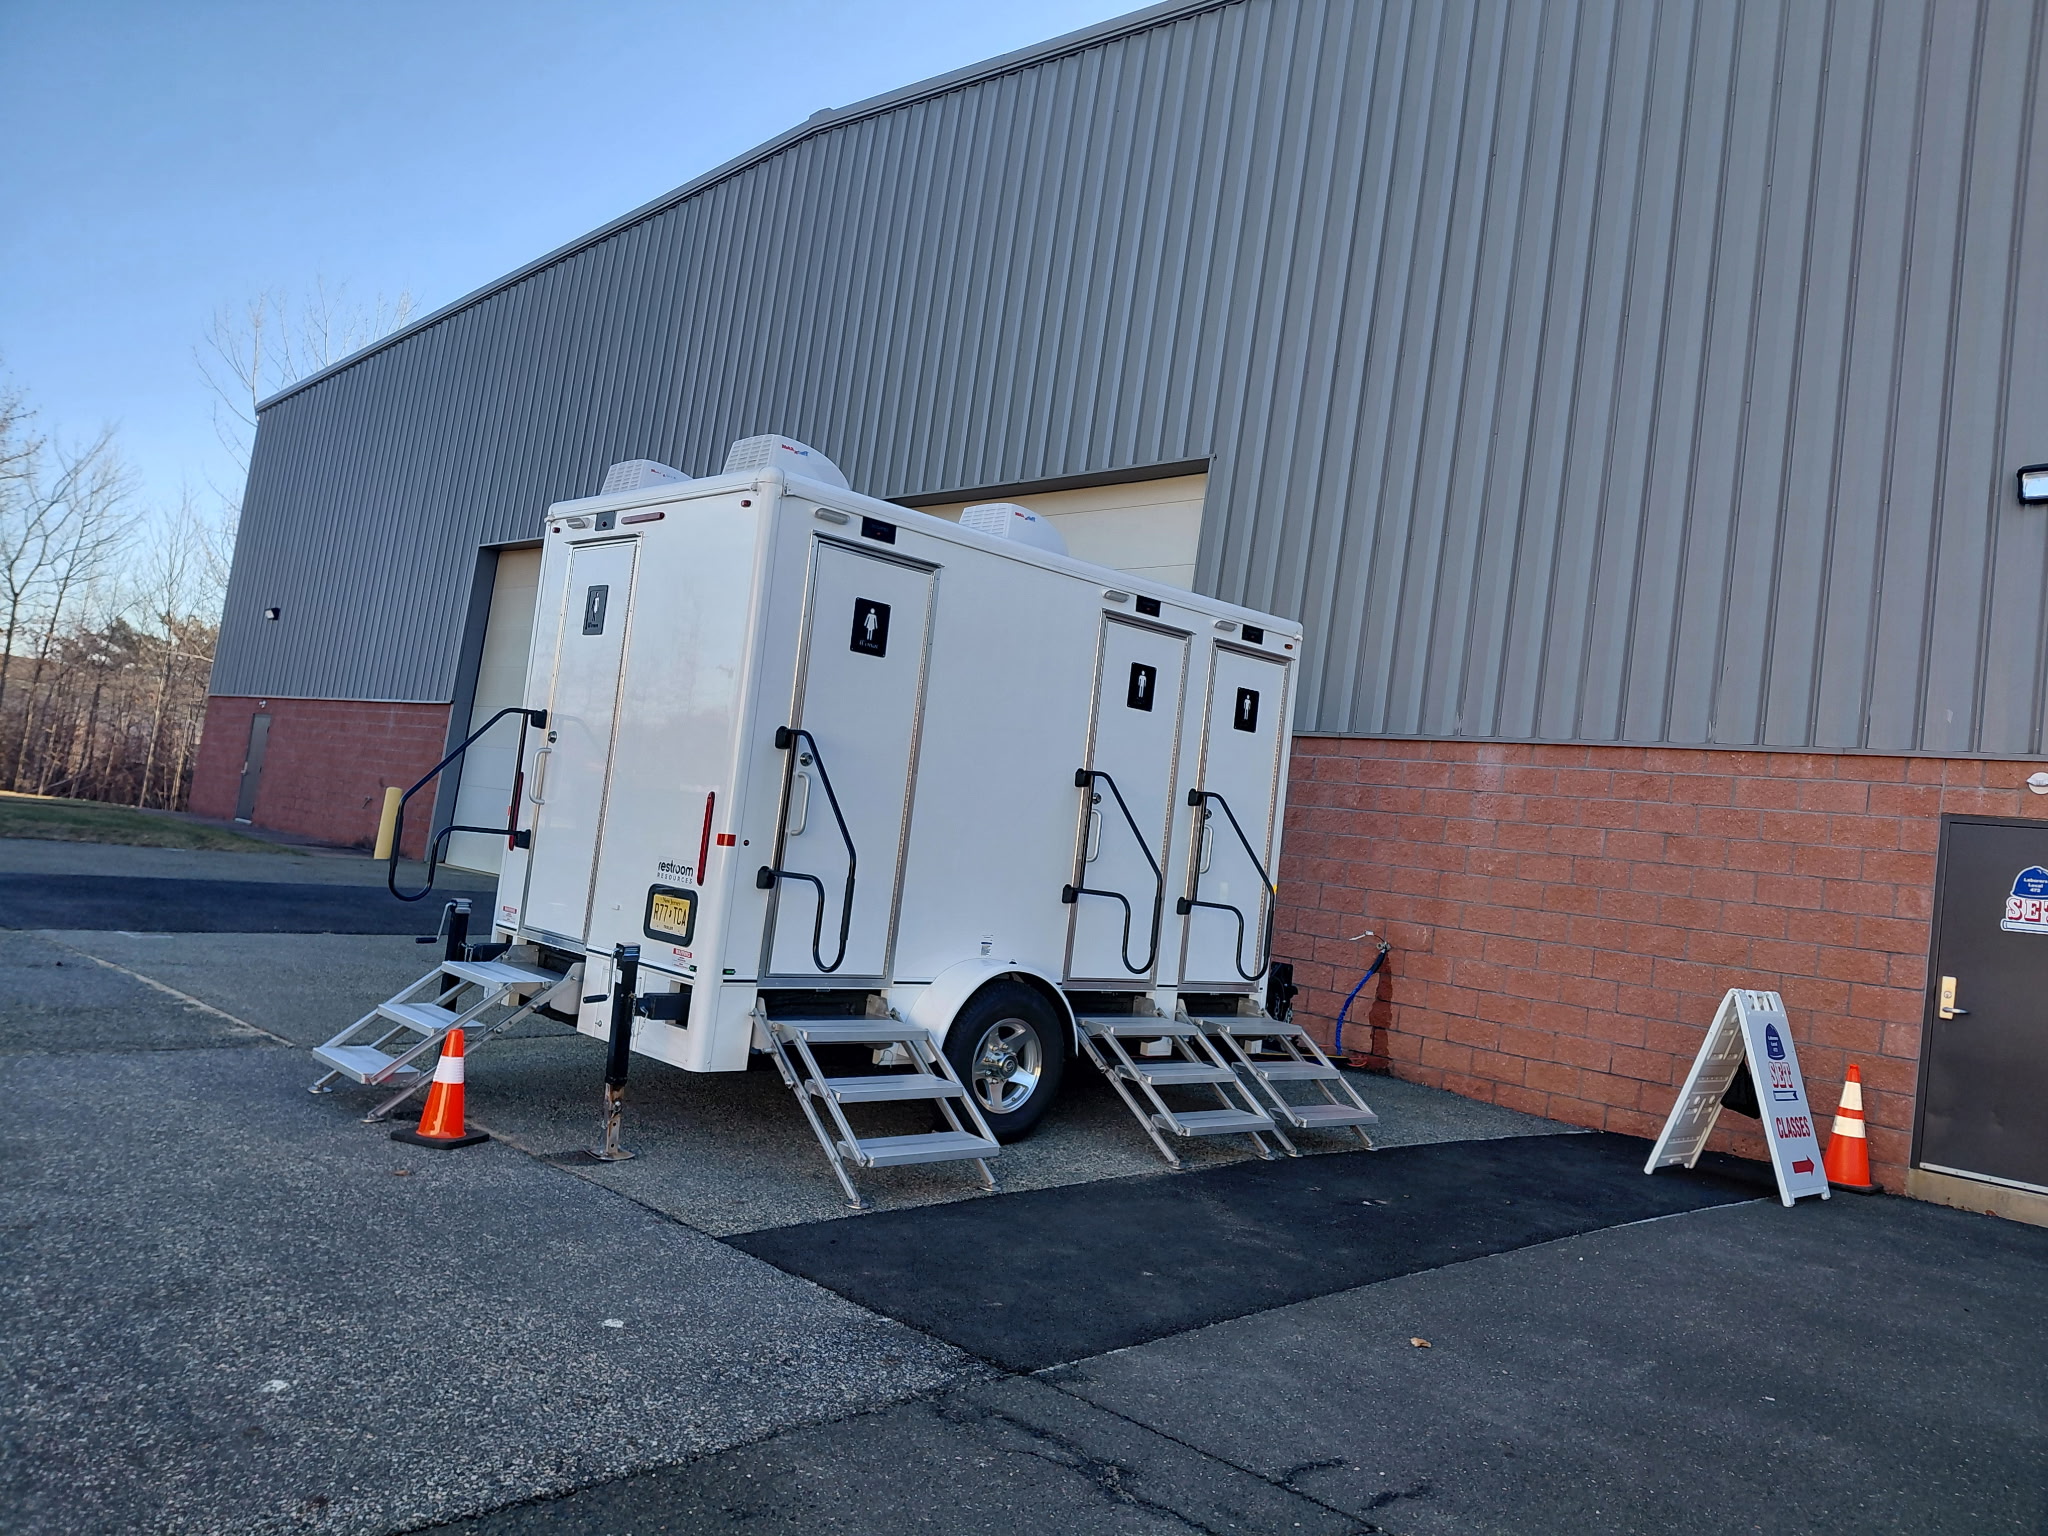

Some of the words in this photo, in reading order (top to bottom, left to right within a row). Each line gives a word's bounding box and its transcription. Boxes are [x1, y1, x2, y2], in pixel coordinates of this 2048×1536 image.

[657, 860, 694, 877] restroom
[657, 872, 693, 884] RESOURCES
[673, 907, 687, 926] TCA
[2007, 897, 2048, 923] SE
[1768, 1061, 1794, 1088] SET
[1776, 1116, 1811, 1139] CLASSES
